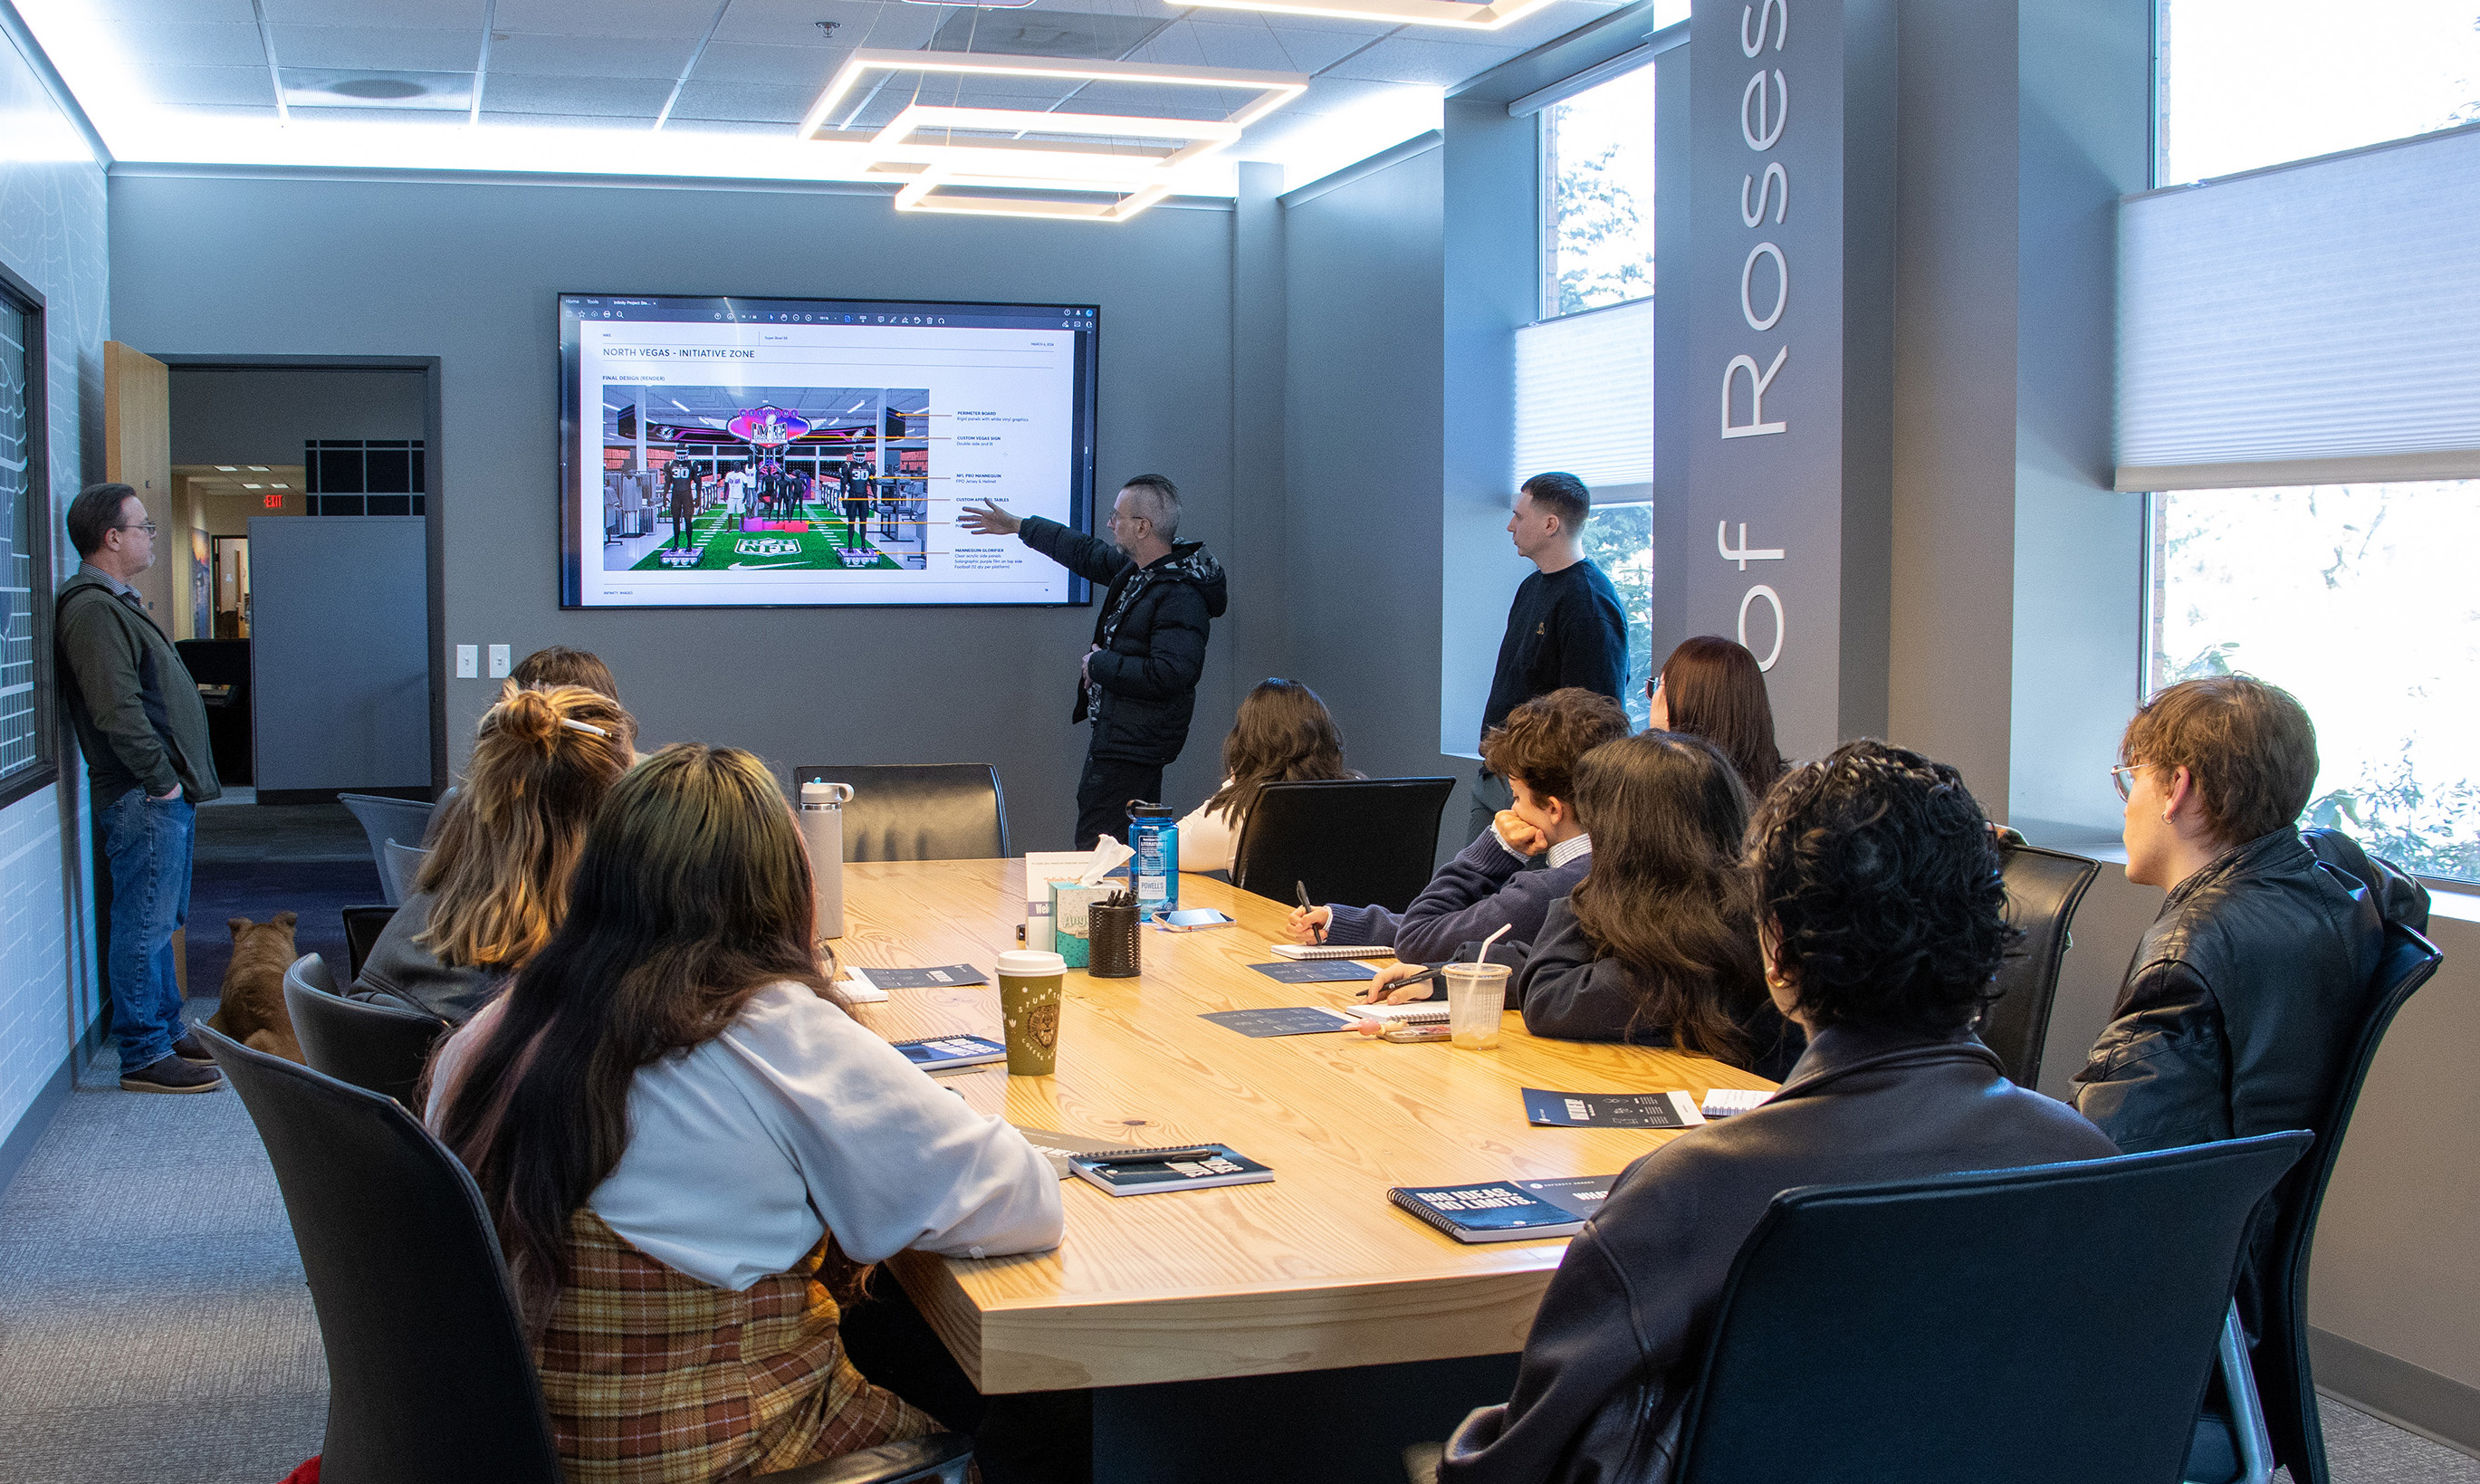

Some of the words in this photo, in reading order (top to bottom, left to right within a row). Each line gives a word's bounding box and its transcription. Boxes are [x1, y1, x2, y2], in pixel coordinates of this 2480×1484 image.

[1719, 0, 1788, 440] Roses
[603, 348, 637, 356] NORTH
[639, 349, 670, 357] VEGAS
[679, 349, 727, 358] INITIATIVE
[729, 350, 755, 358] ZONE
[672, 468, 689, 478] 30
[852, 470, 869, 480] 30
[266, 495, 282, 508] EXIT
[1718, 520, 1786, 673] of
[1063, 913, 1088, 928] Ang
[1021, 1038, 1043, 1061] COFFEE
[1416, 1192, 1451, 1203] BIG
[1451, 1188, 1518, 1202] IDEAS.
[1431, 1201, 1465, 1211] NO
[1461, 1197, 1537, 1209] LIMITS.
